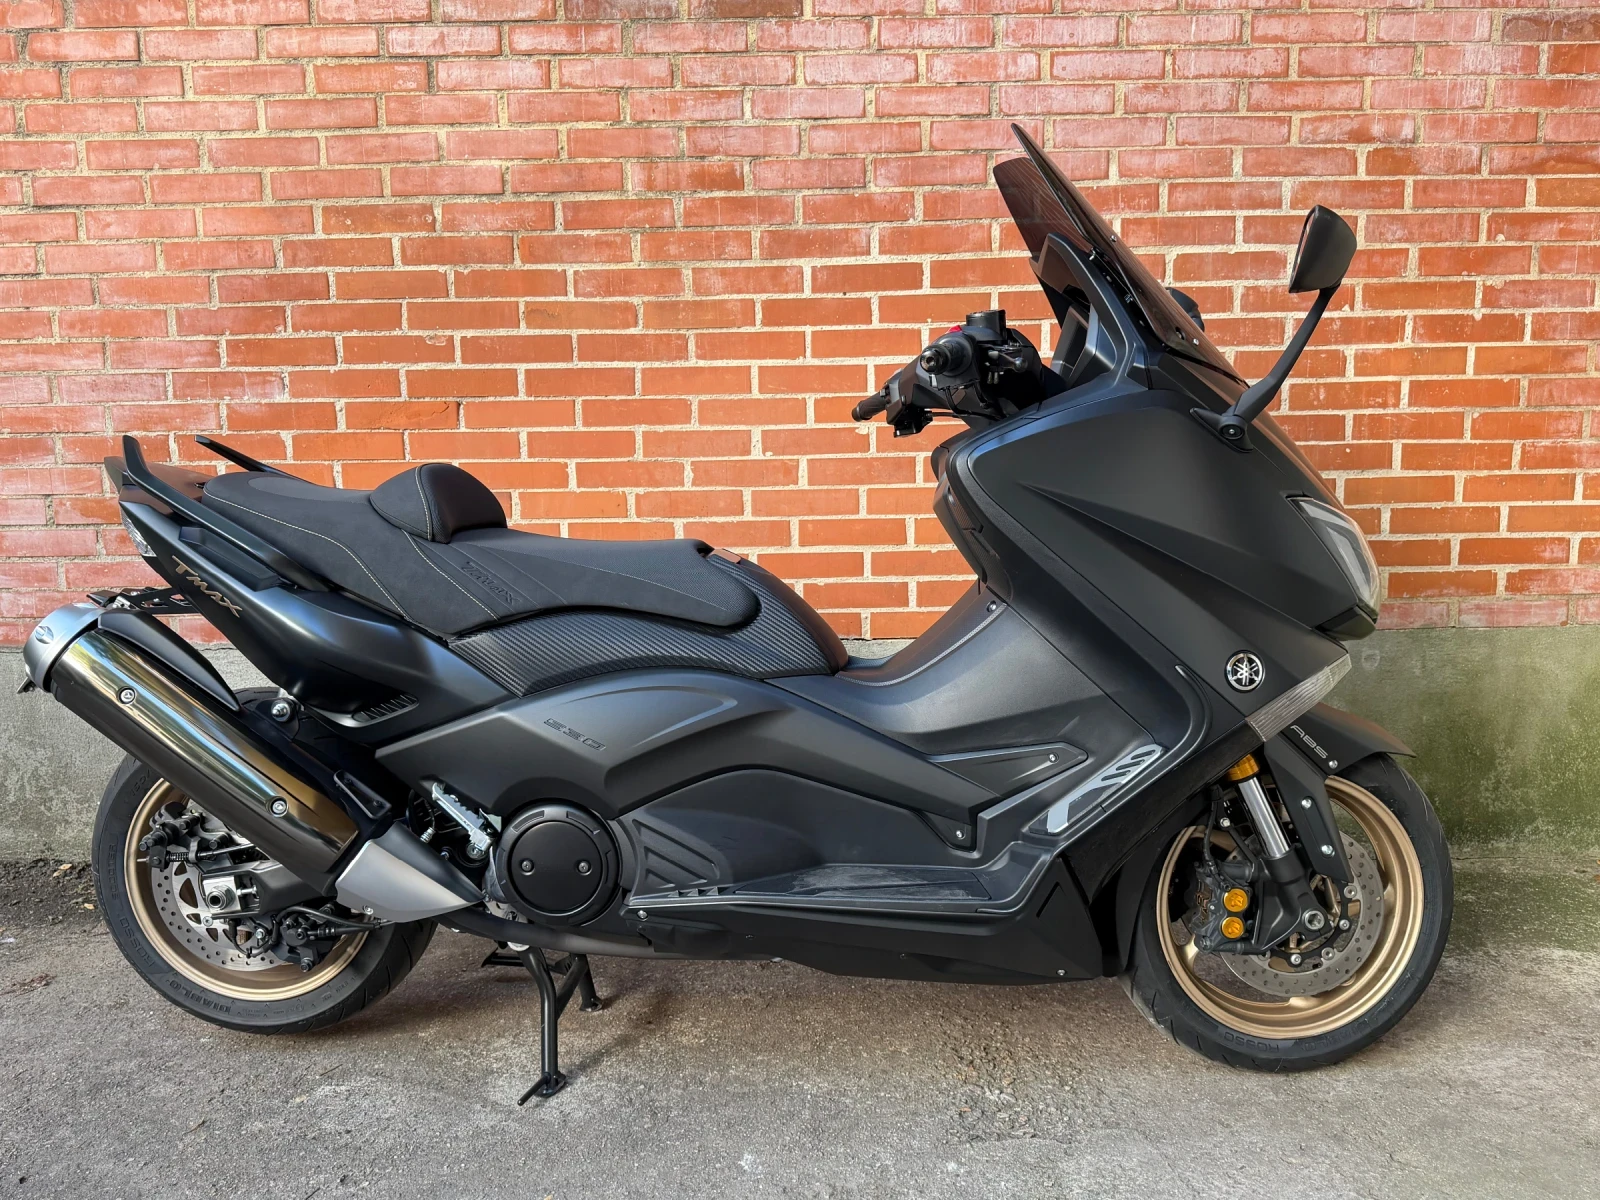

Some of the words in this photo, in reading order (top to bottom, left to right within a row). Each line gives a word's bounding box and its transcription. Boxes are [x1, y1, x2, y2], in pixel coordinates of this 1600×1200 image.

[1290, 724, 1329, 759] ABS
[119, 916, 155, 968] ROSSO
[1224, 1031, 1279, 1053] ROSSO
